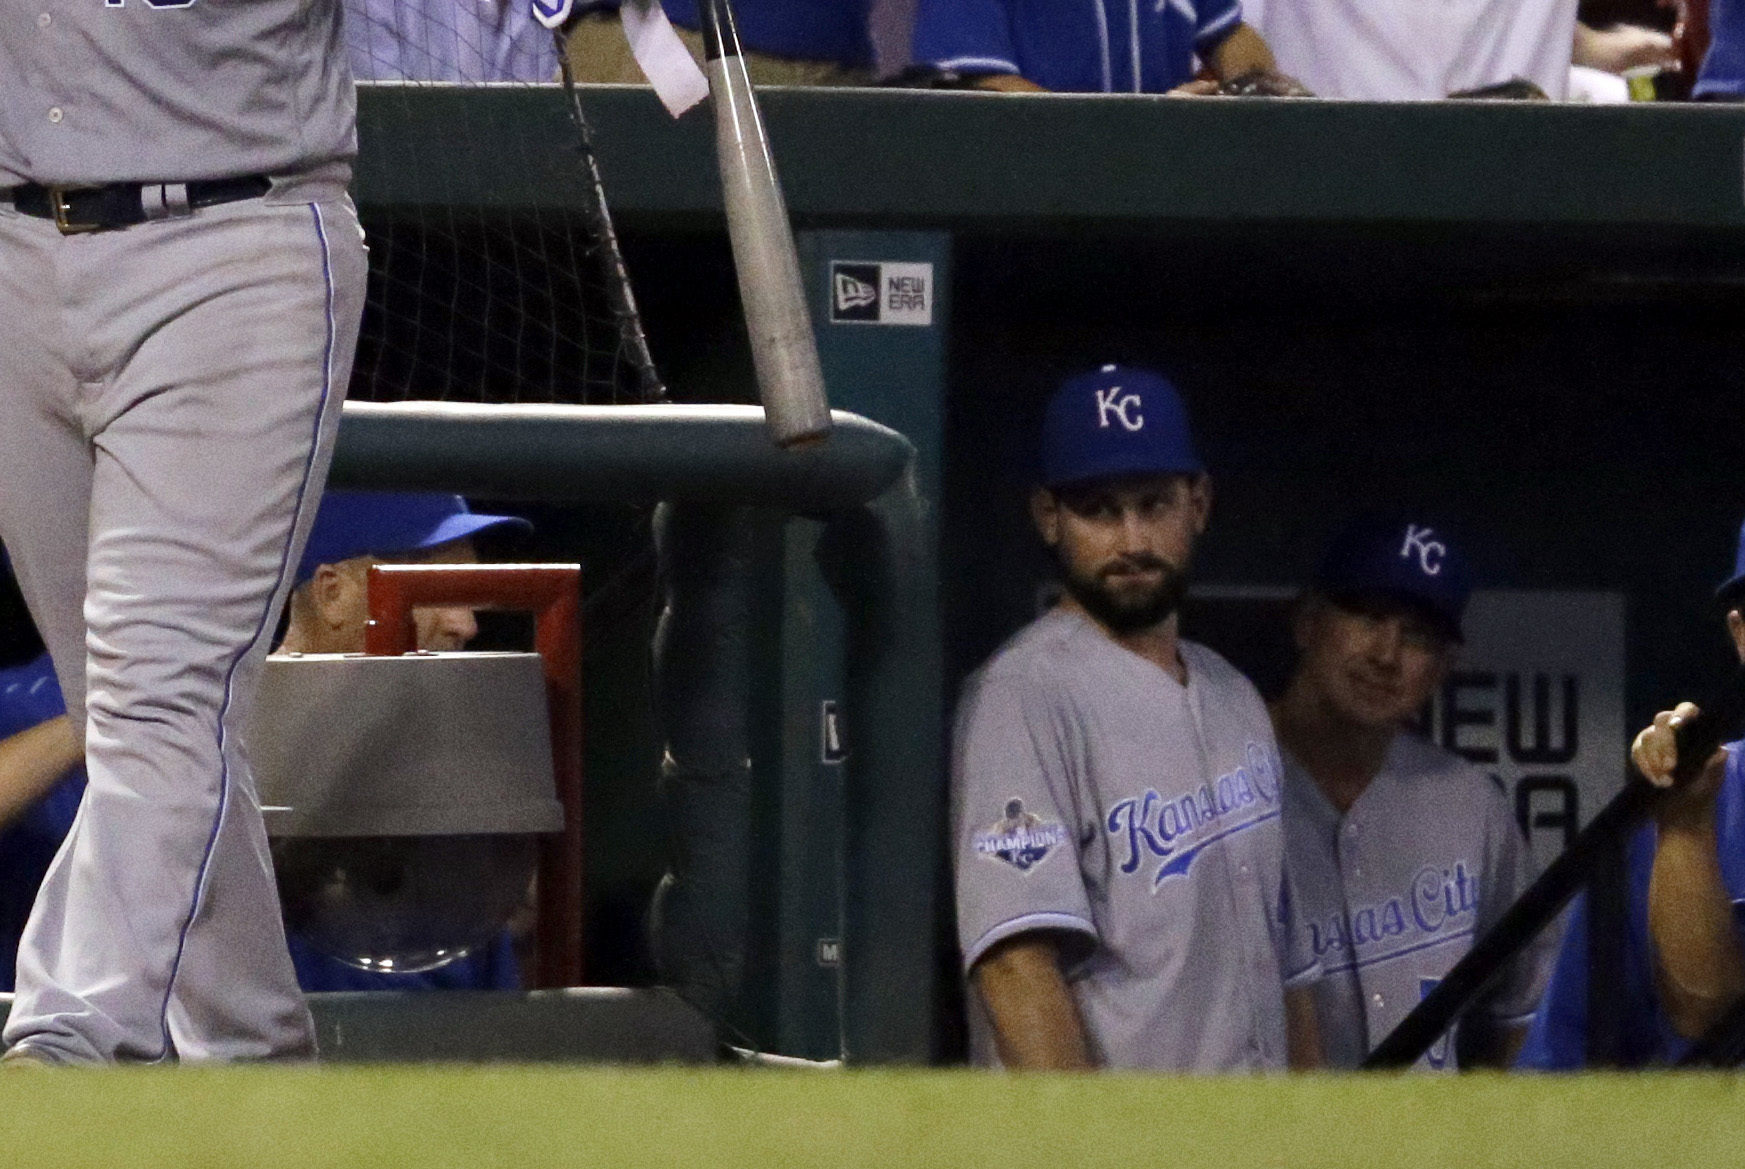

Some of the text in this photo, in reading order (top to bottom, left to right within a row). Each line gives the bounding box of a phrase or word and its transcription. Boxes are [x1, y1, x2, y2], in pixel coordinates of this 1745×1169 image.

[888, 276, 925, 293] NEW
[888, 293, 925, 311] ERA
[1096, 386, 1145, 432] KC
[1399, 523, 1446, 576] KC
[1428, 671, 1580, 765] EW
[1108, 765, 1255, 874] Kansas
